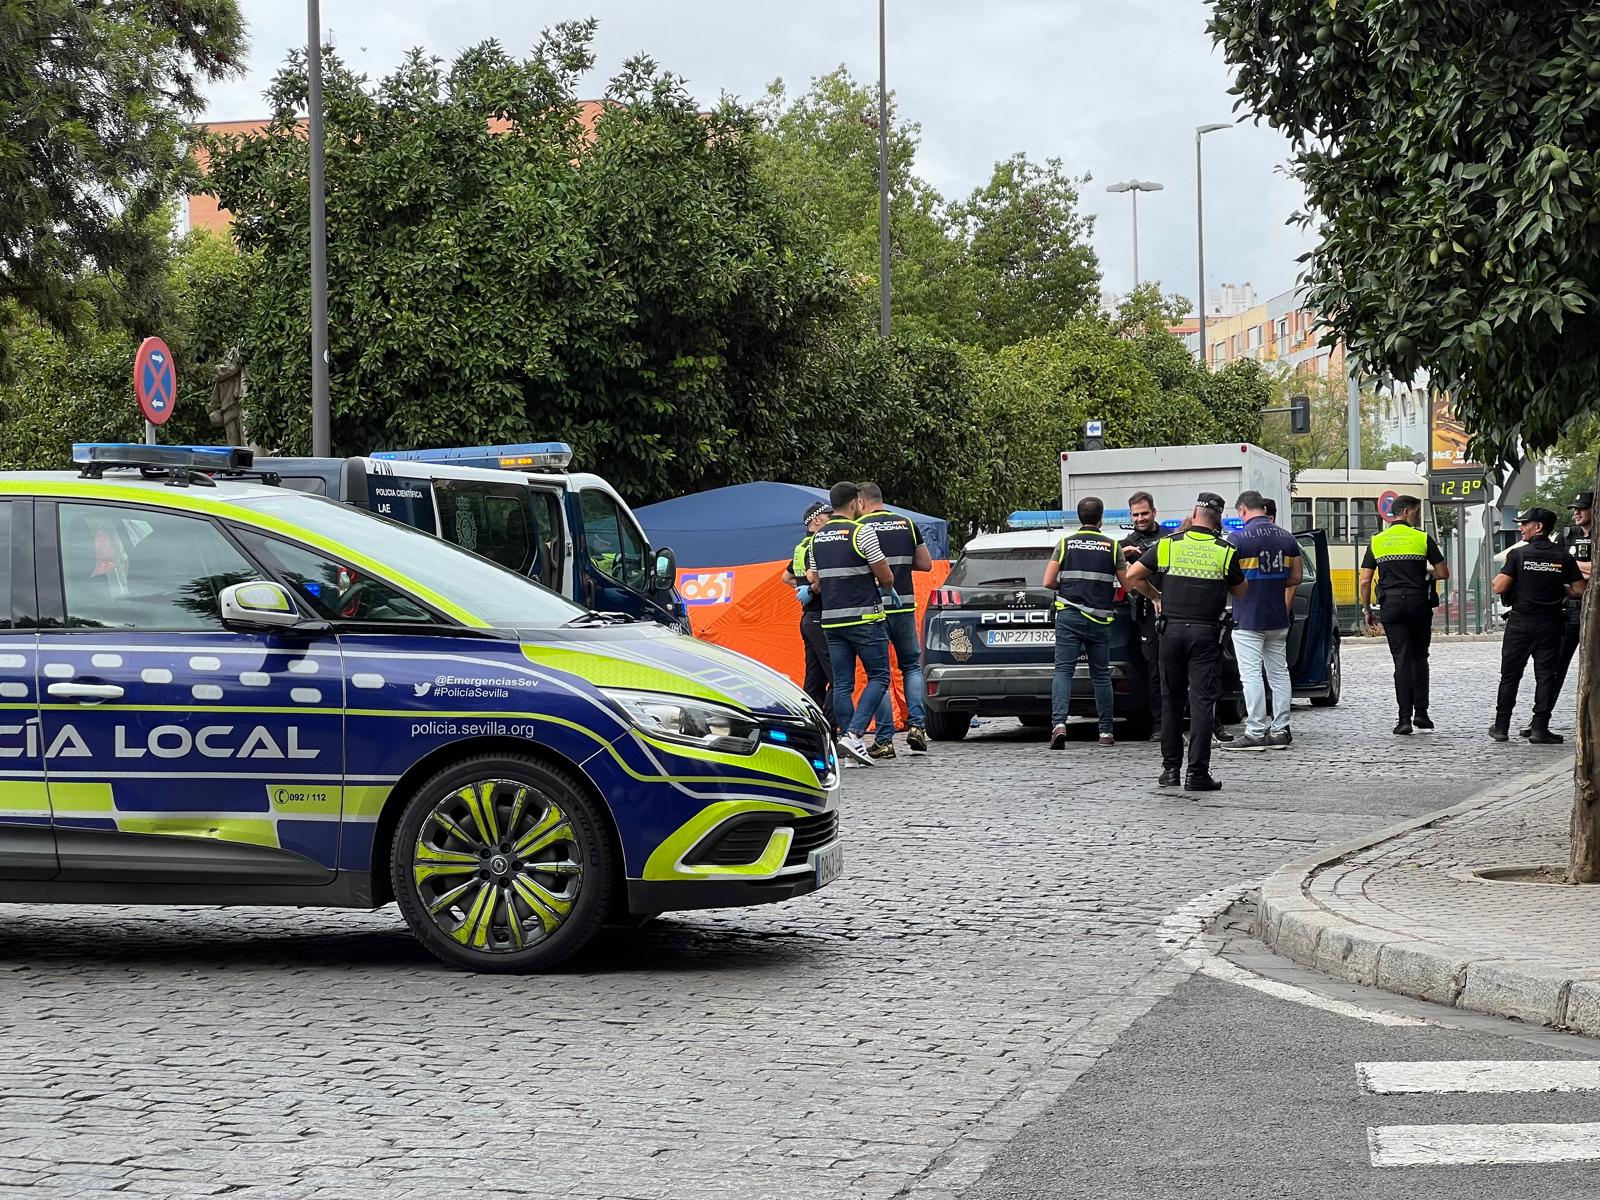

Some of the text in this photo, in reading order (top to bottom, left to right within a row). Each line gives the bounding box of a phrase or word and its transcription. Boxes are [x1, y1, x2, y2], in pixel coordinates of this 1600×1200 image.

[377, 503, 392, 513] LAE
[1067, 544, 1111, 553] NACIONAL
[1181, 550, 1214, 559] LOCAL
[1175, 556, 1218, 567] SEVILLA
[1523, 565, 1562, 573] NACIONAL
[981, 609, 1052, 624] POLICÍ
[434, 675, 540, 689] @EmergenciasSev
[411, 721, 535, 739] policia.sevilla.org
[115, 725, 321, 759] LOCAL
[289, 792, 304, 802] 092
[312, 792, 327, 802] 112
